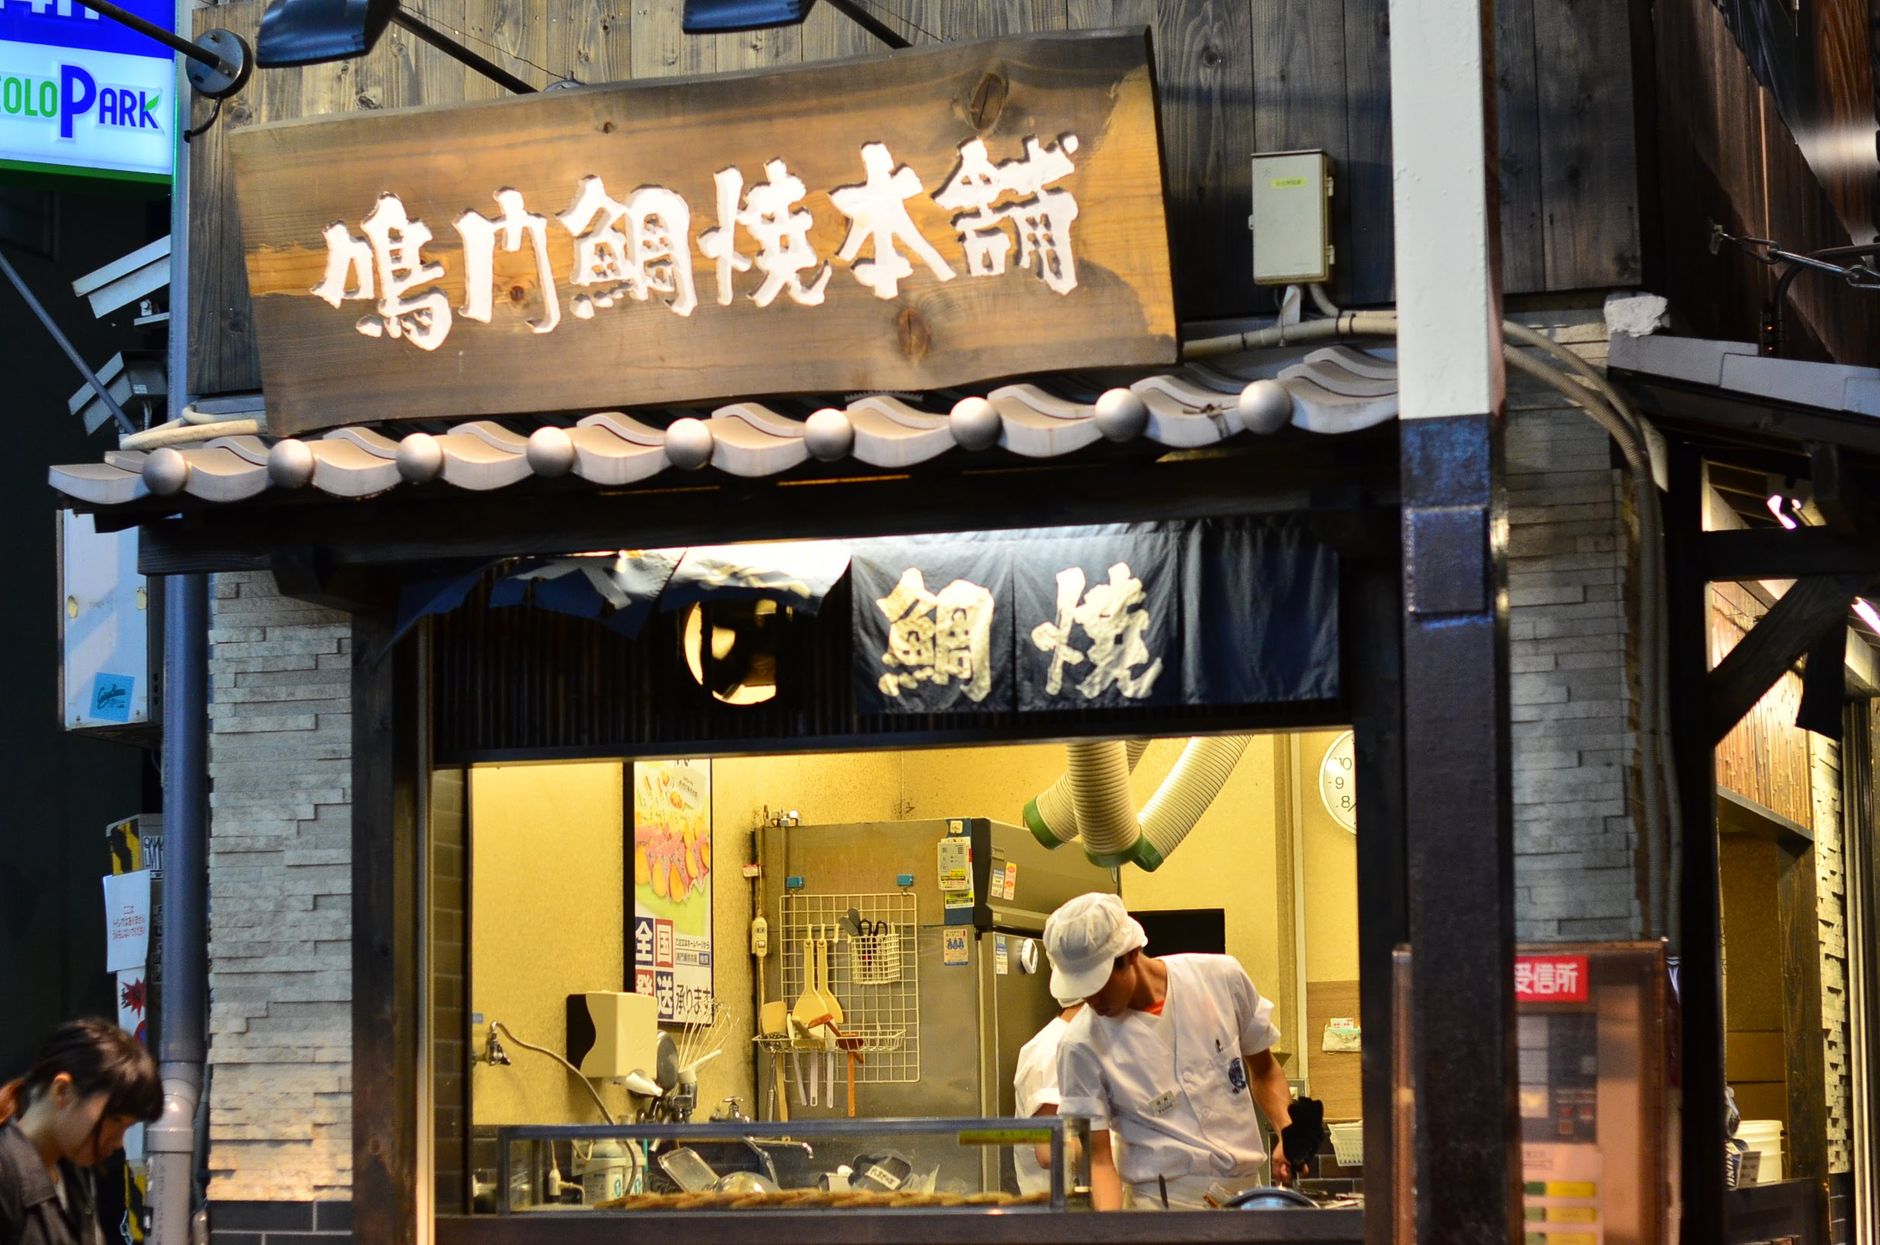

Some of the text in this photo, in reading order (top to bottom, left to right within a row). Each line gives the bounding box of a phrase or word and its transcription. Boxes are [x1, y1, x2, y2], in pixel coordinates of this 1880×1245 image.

[0, 64, 160, 139] OLOPARK
[312, 134, 1079, 350] 鳴門鯛焼本舗
[876, 561, 1162, 702] 鯛焼
[1335, 776, 1344, 790] 9
[1341, 795, 1351, 809] 8
[1514, 961, 1579, 994] 受信所
